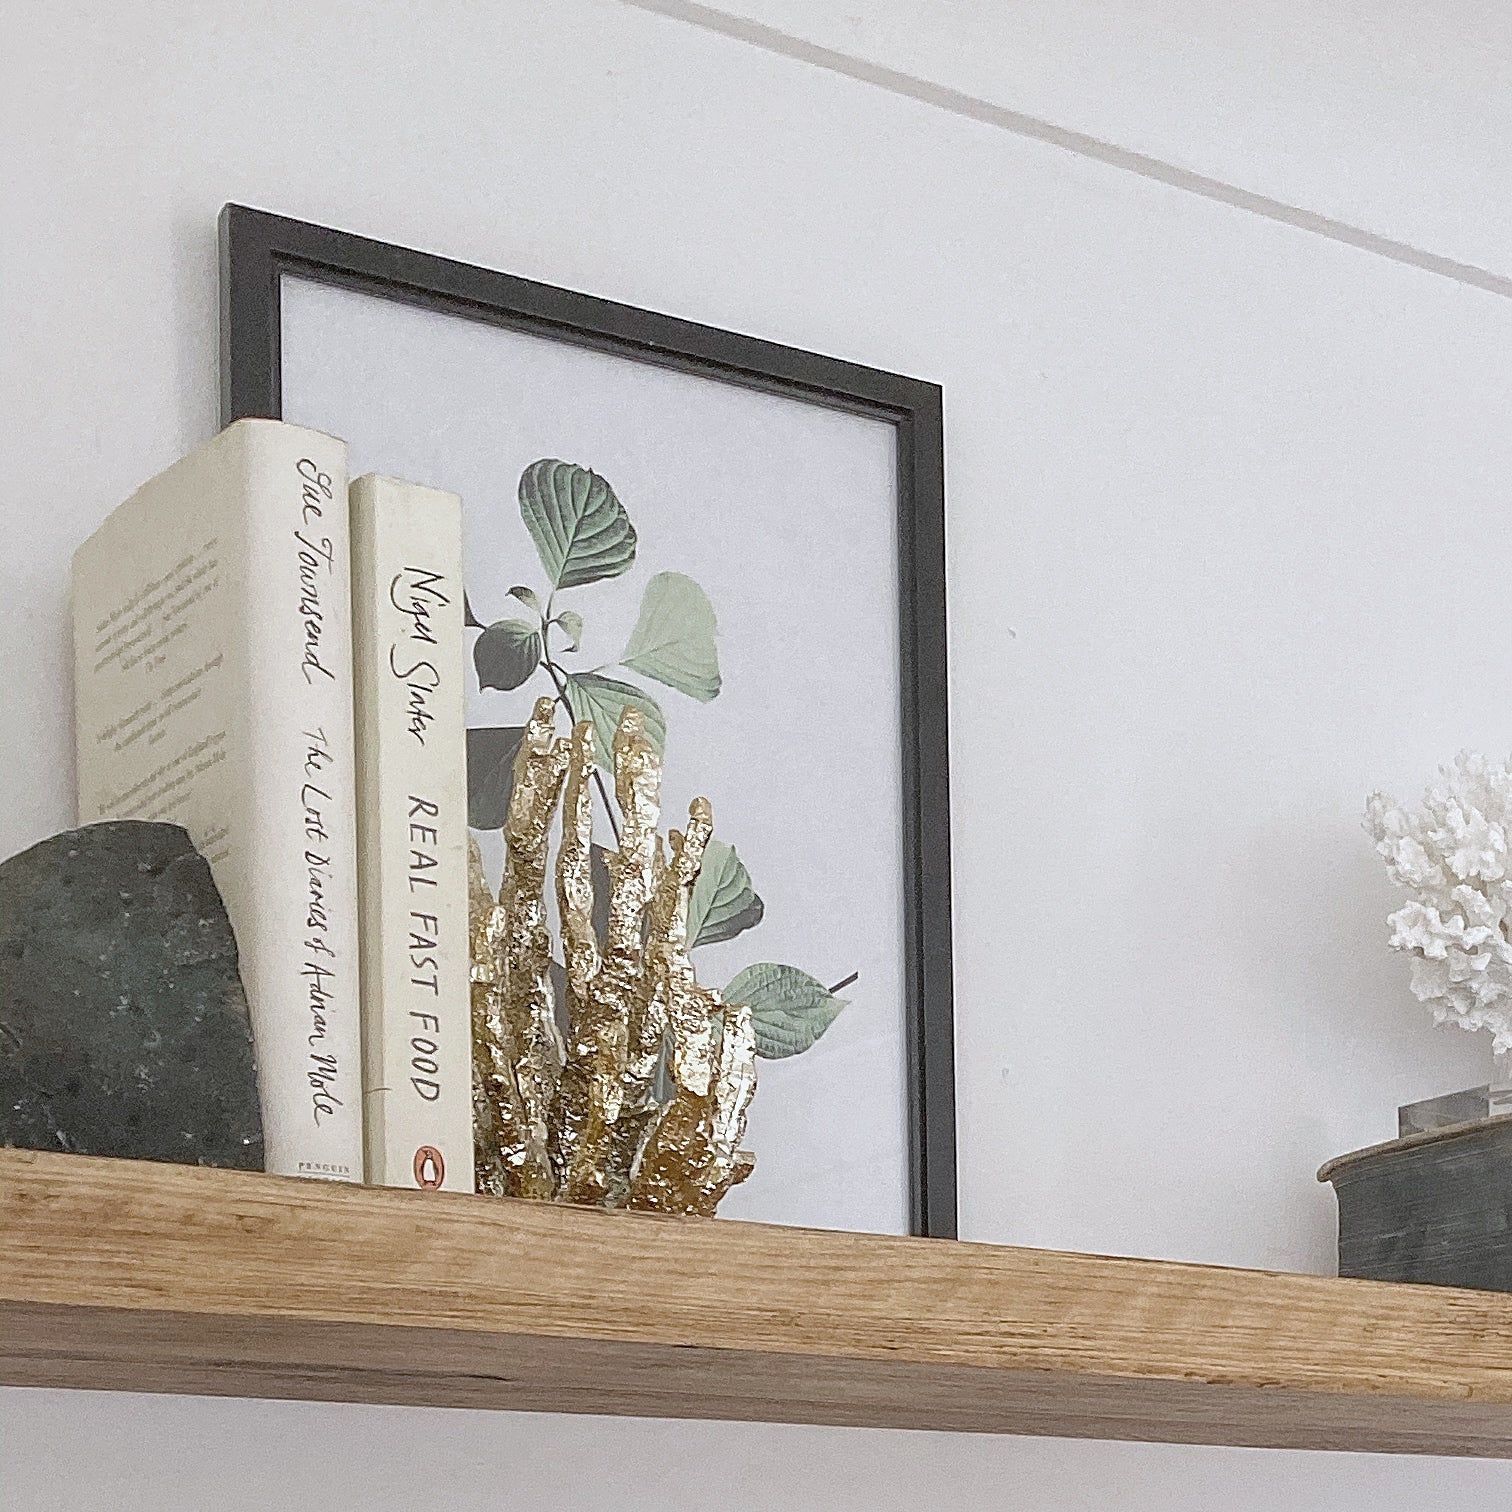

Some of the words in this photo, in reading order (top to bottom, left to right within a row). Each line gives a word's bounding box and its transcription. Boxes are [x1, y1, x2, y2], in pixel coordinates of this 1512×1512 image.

[296, 458, 334, 526] Sue
[294, 530, 336, 685] Townsend
[389, 565, 451, 646] Nigel
[390, 643, 441, 747] Slater
[301, 727, 334, 785] The
[301, 784, 333, 843] Lost
[408, 795, 439, 893] REAL
[303, 850, 333, 932] Diaries
[304, 934, 335, 958] of
[408, 911, 440, 995] FAST
[300, 961, 336, 1047] Adrian
[306, 1055, 344, 1128] Mole
[408, 1009, 441, 1102] FOOD
[298, 1162, 350, 1174] PENGUIN
